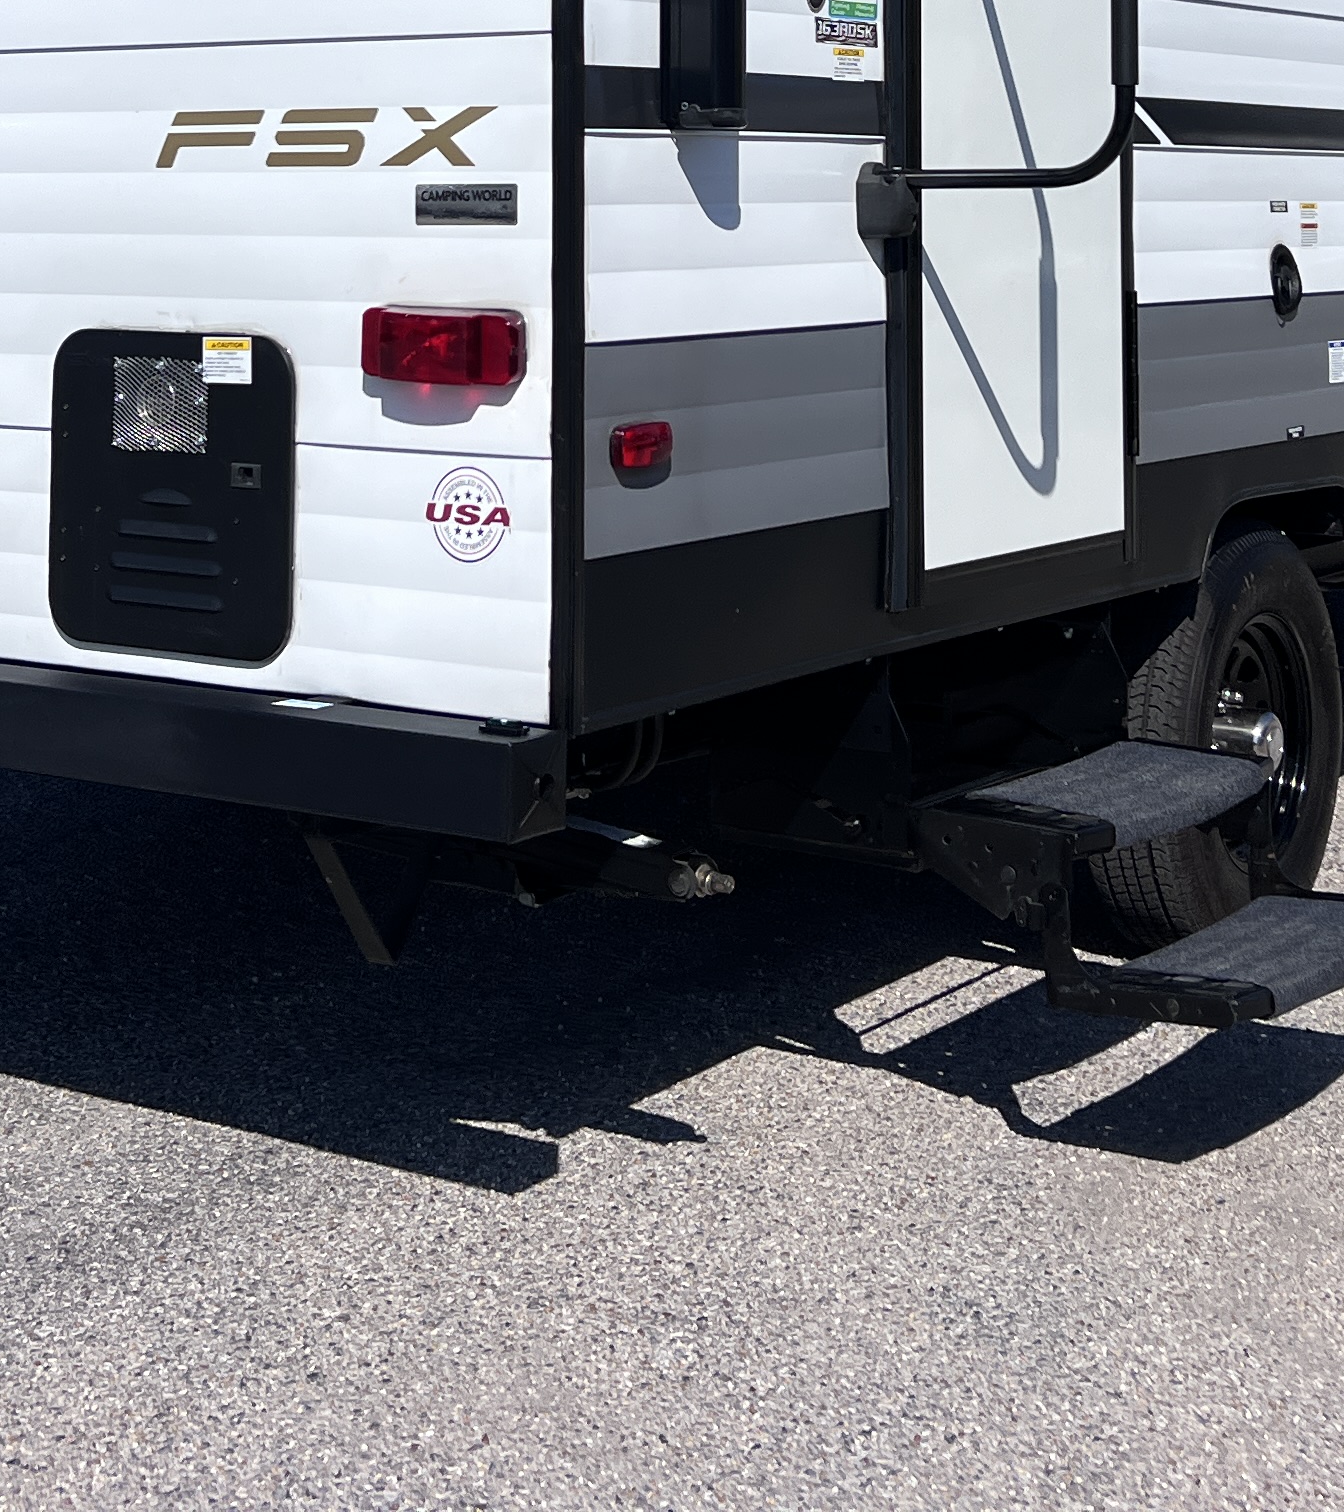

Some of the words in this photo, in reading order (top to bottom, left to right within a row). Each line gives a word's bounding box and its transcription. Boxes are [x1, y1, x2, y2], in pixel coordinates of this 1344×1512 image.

[155, 105, 499, 169] FSX
[421, 190, 471, 202] CAMPING
[471, 189, 513, 202] WORLD
[425, 502, 510, 527] USA
